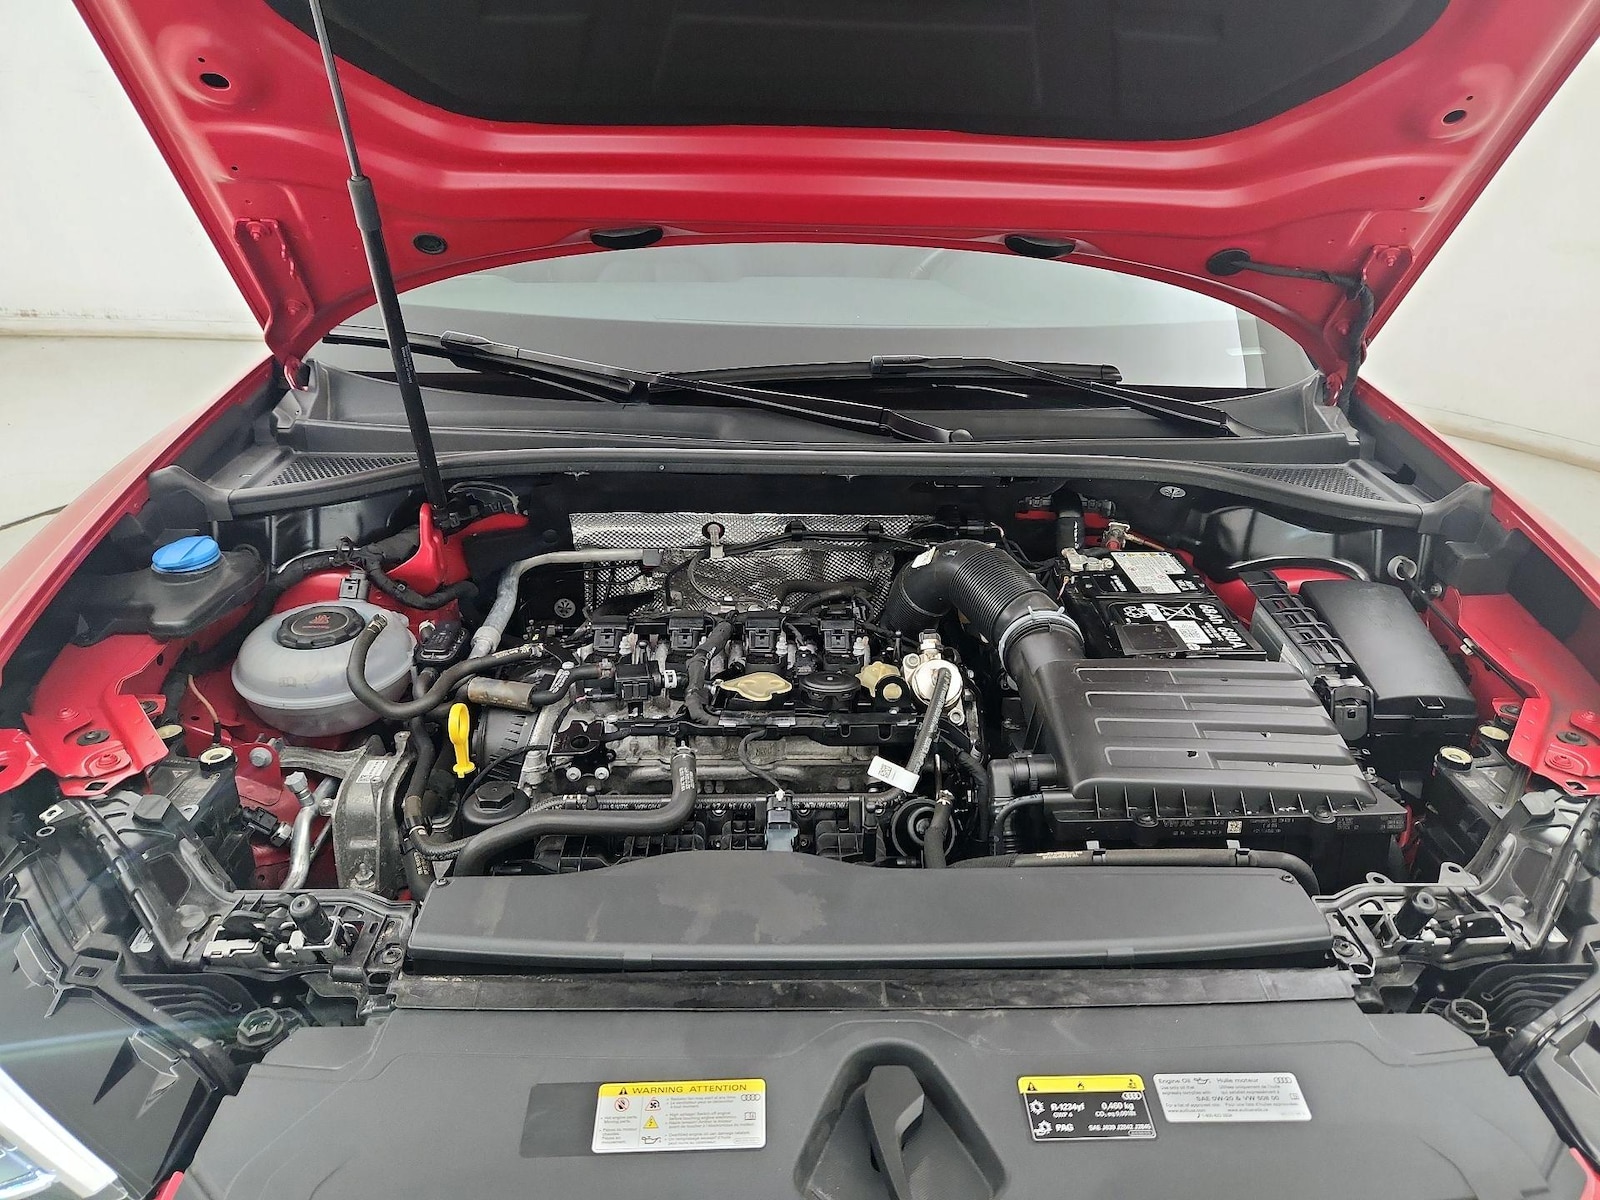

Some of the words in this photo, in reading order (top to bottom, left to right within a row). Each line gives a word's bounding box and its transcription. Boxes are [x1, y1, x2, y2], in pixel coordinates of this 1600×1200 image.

[1199, 604, 1226, 625] 68Ah
[1217, 626, 1247, 648] 680A
[632, 1086, 684, 1095] WARNING
[689, 1084, 747, 1094] ATTENTION
[1055, 1122, 1075, 1132] PAG
